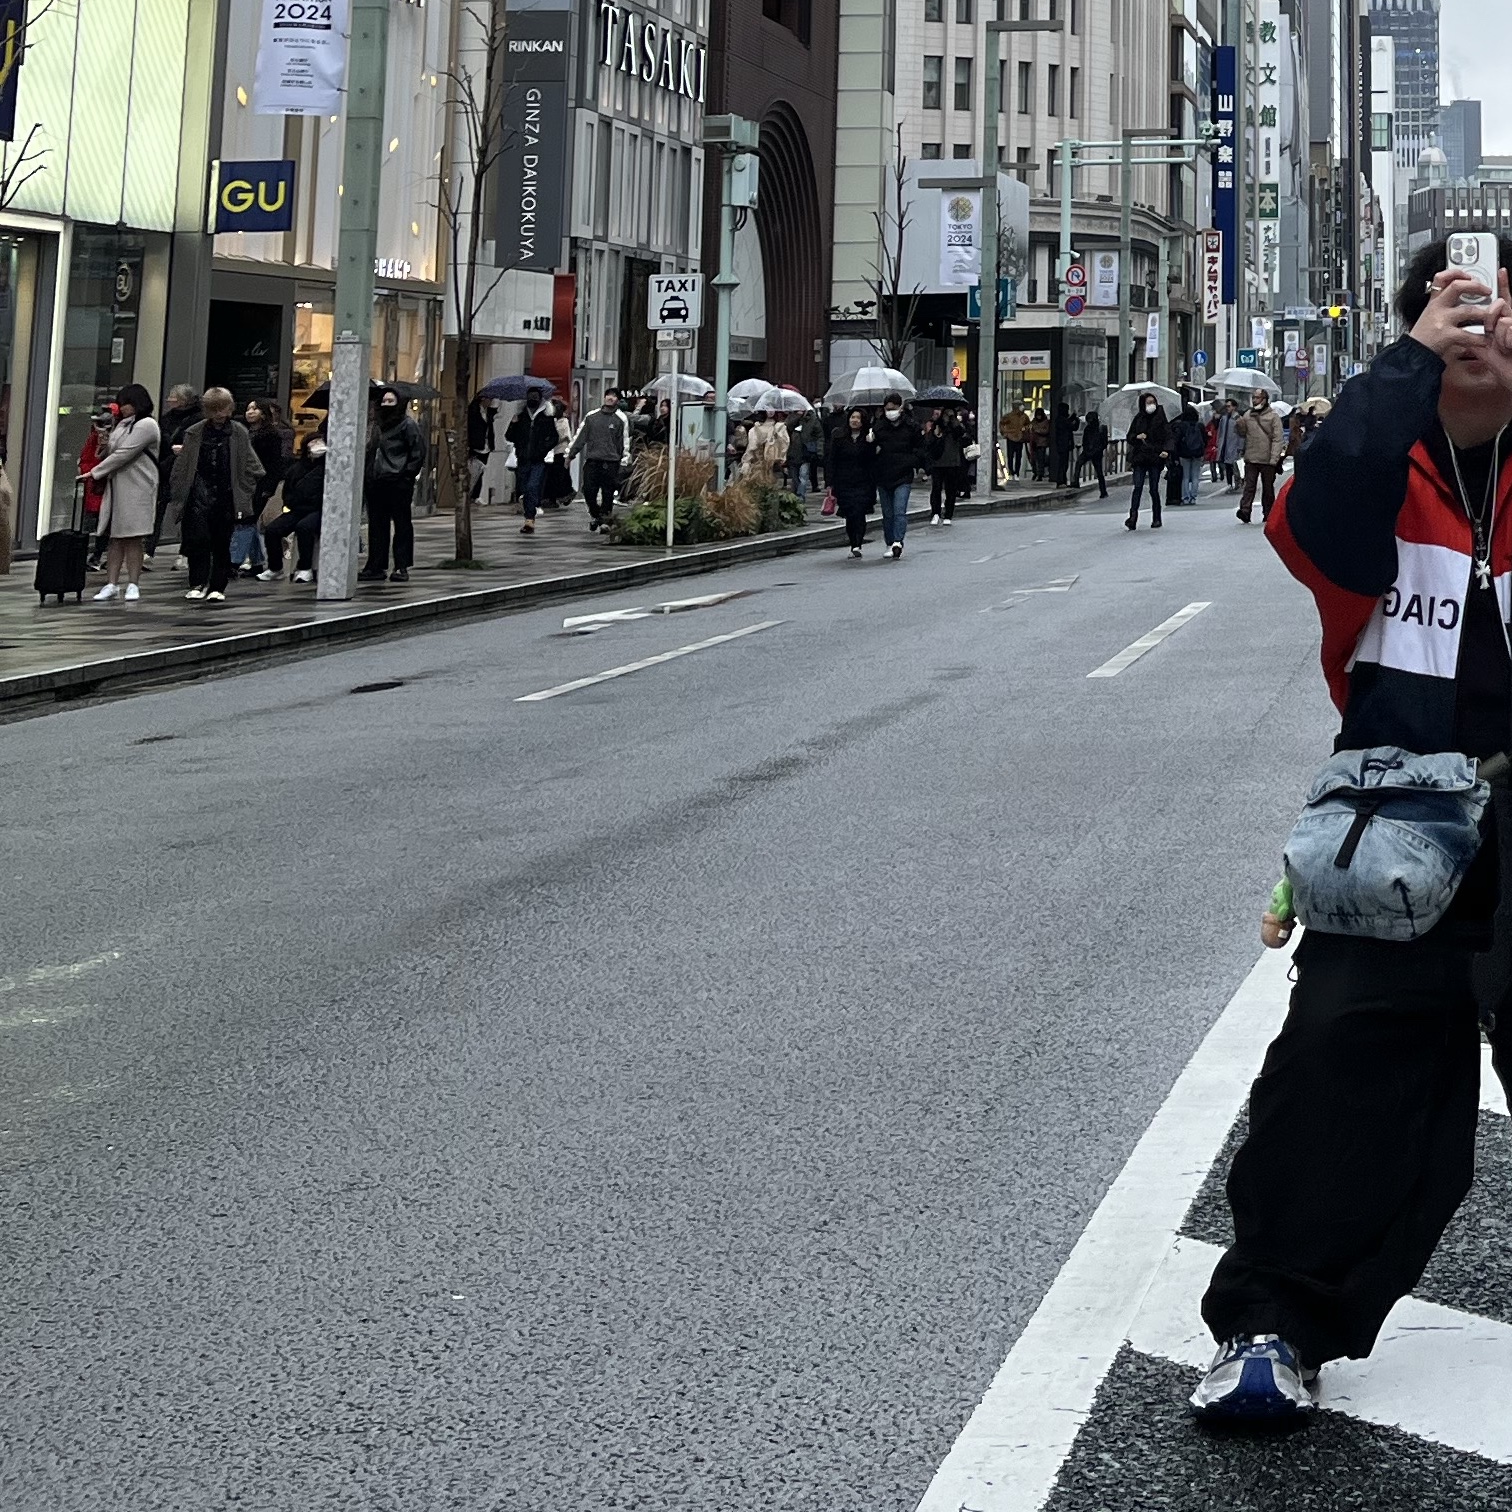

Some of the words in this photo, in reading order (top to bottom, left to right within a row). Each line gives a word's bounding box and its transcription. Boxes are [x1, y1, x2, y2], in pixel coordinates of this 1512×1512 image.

[275, 4, 332, 21] 2024
[508, 40, 564, 54] RINKAN
[600, 3, 707, 103] TASAKI
[1258, 20, 1277, 128] 教文館
[523, 88, 541, 147] GINZA
[1217, 94, 1234, 189] 山野楽器
[221, 179, 286, 213] GU
[519, 155, 538, 261] DAIKOKUYA
[1259, 188, 1277, 213] 本
[947, 235, 973, 243] 2024
[655, 279, 696, 293] TAXI
